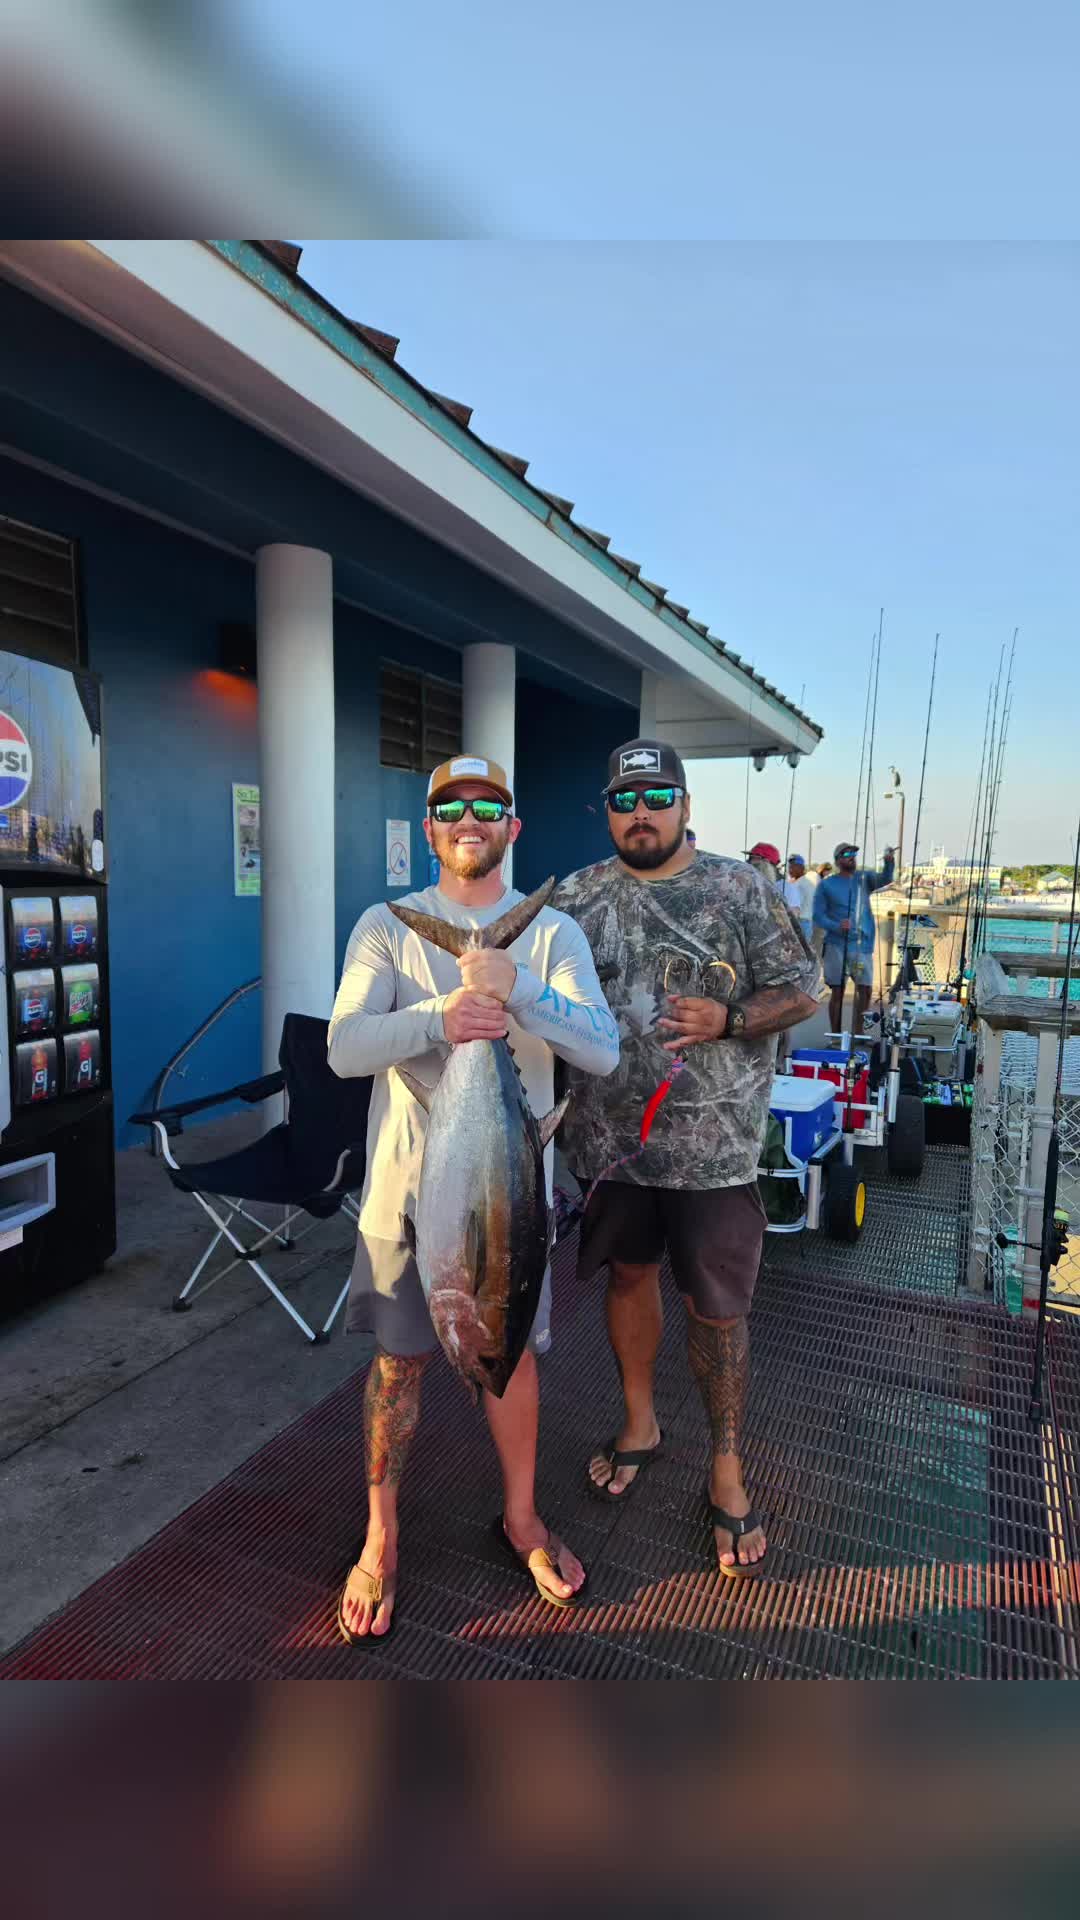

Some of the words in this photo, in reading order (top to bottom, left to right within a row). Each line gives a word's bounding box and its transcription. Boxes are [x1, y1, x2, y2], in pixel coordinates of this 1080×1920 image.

[0, 752, 27, 772] SI
[80, 1060, 89, 1072] G
[35, 1070, 45, 1083] G
